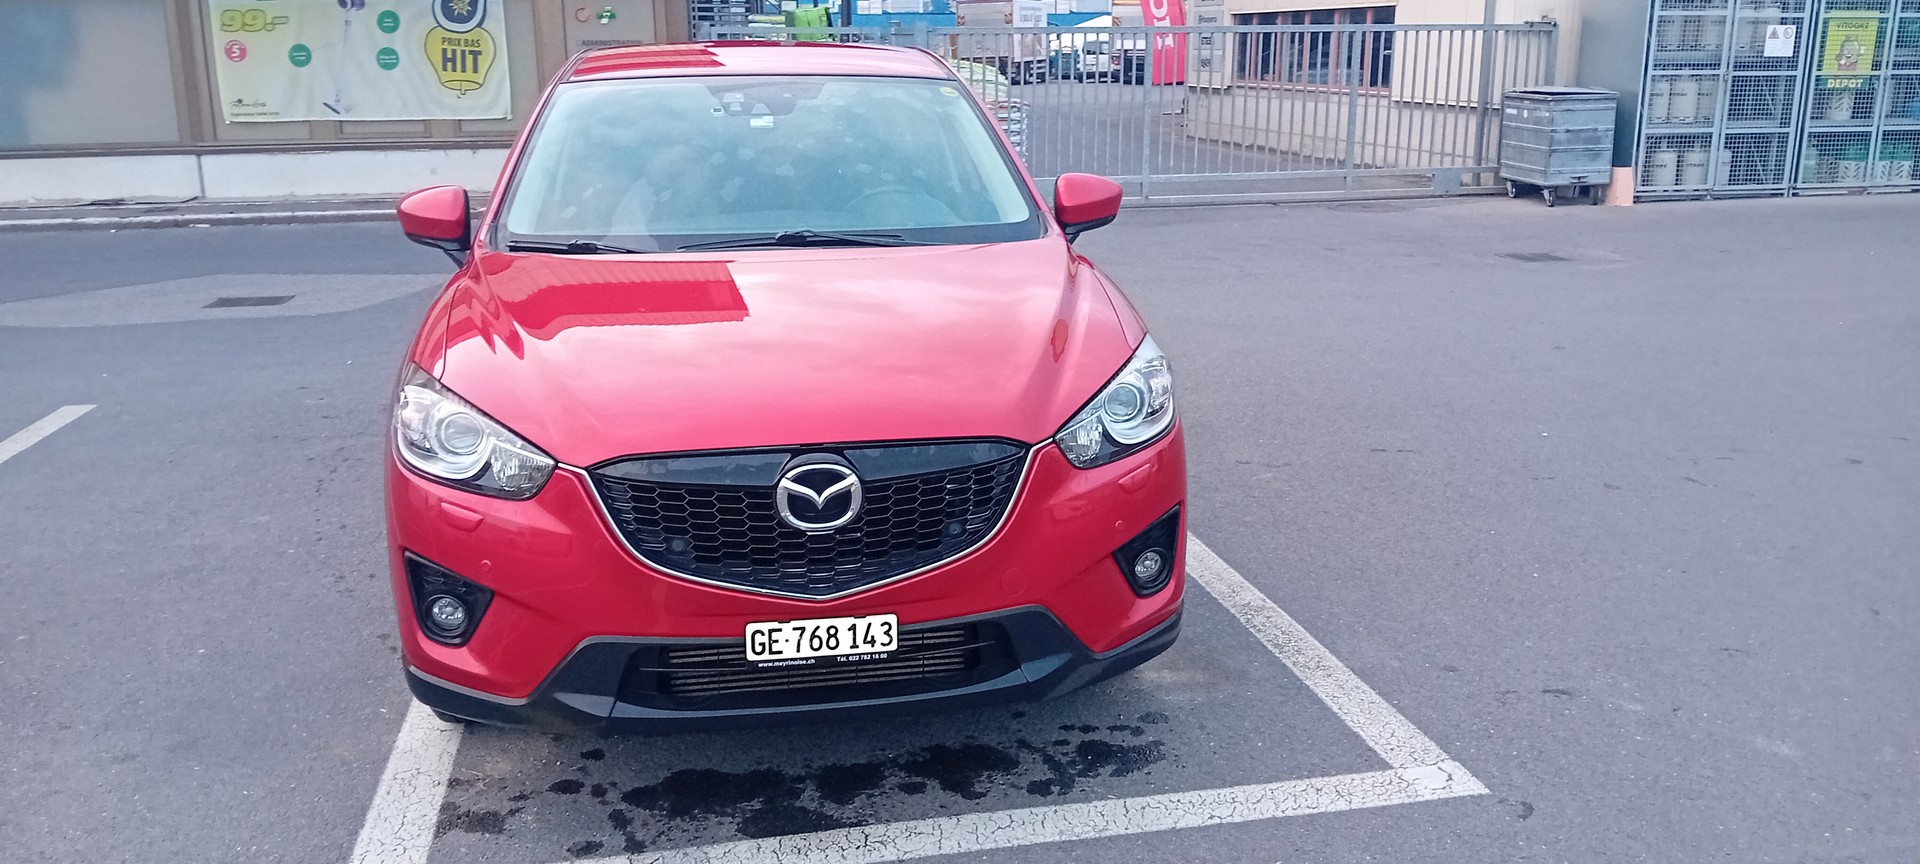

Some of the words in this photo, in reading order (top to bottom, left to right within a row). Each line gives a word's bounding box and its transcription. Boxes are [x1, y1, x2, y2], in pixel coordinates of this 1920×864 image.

[441, 37, 461, 46] PRIX
[463, 38, 481, 47] BAS
[441, 47, 482, 74] HIT
[1827, 79, 1863, 88] DEPOT
[847, 621, 893, 650] 143
